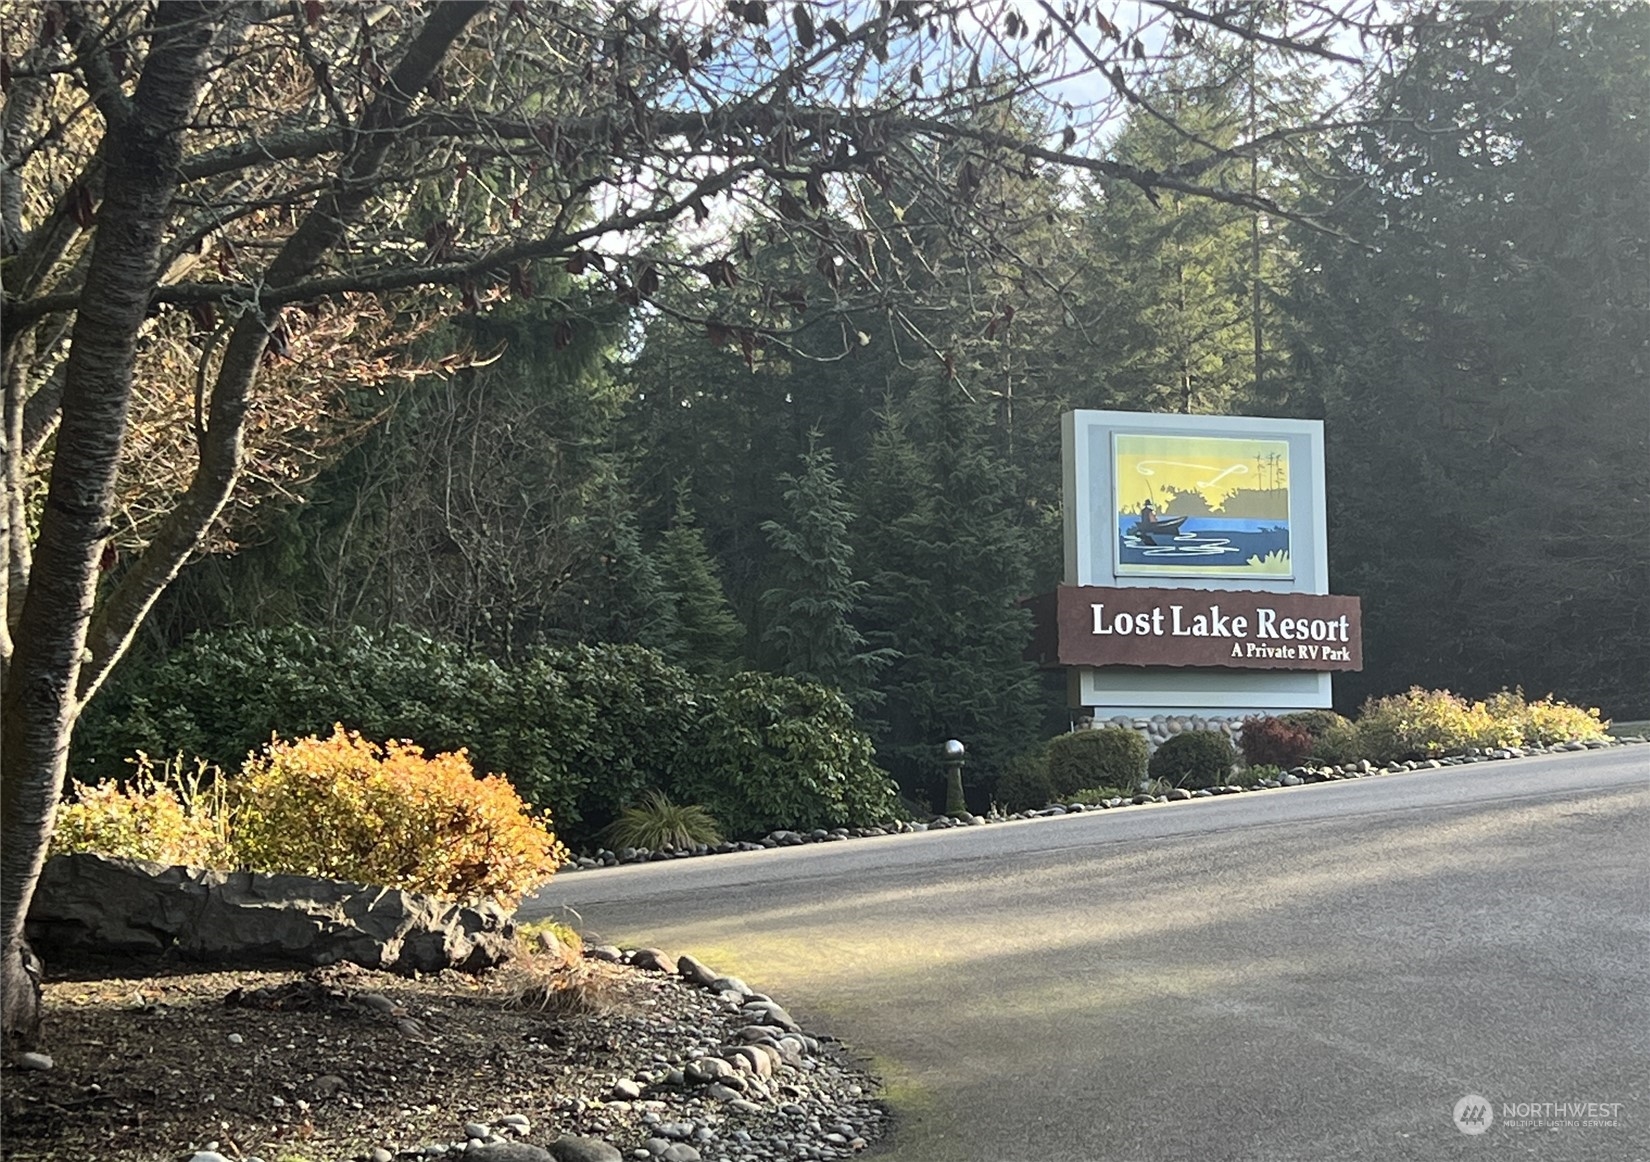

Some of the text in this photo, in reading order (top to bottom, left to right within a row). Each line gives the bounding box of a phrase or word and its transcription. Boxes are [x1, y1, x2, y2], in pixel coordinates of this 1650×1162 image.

[1091, 604, 1350, 642] Lost Lake Resort
[1231, 643, 1351, 661] A Private RV Park
